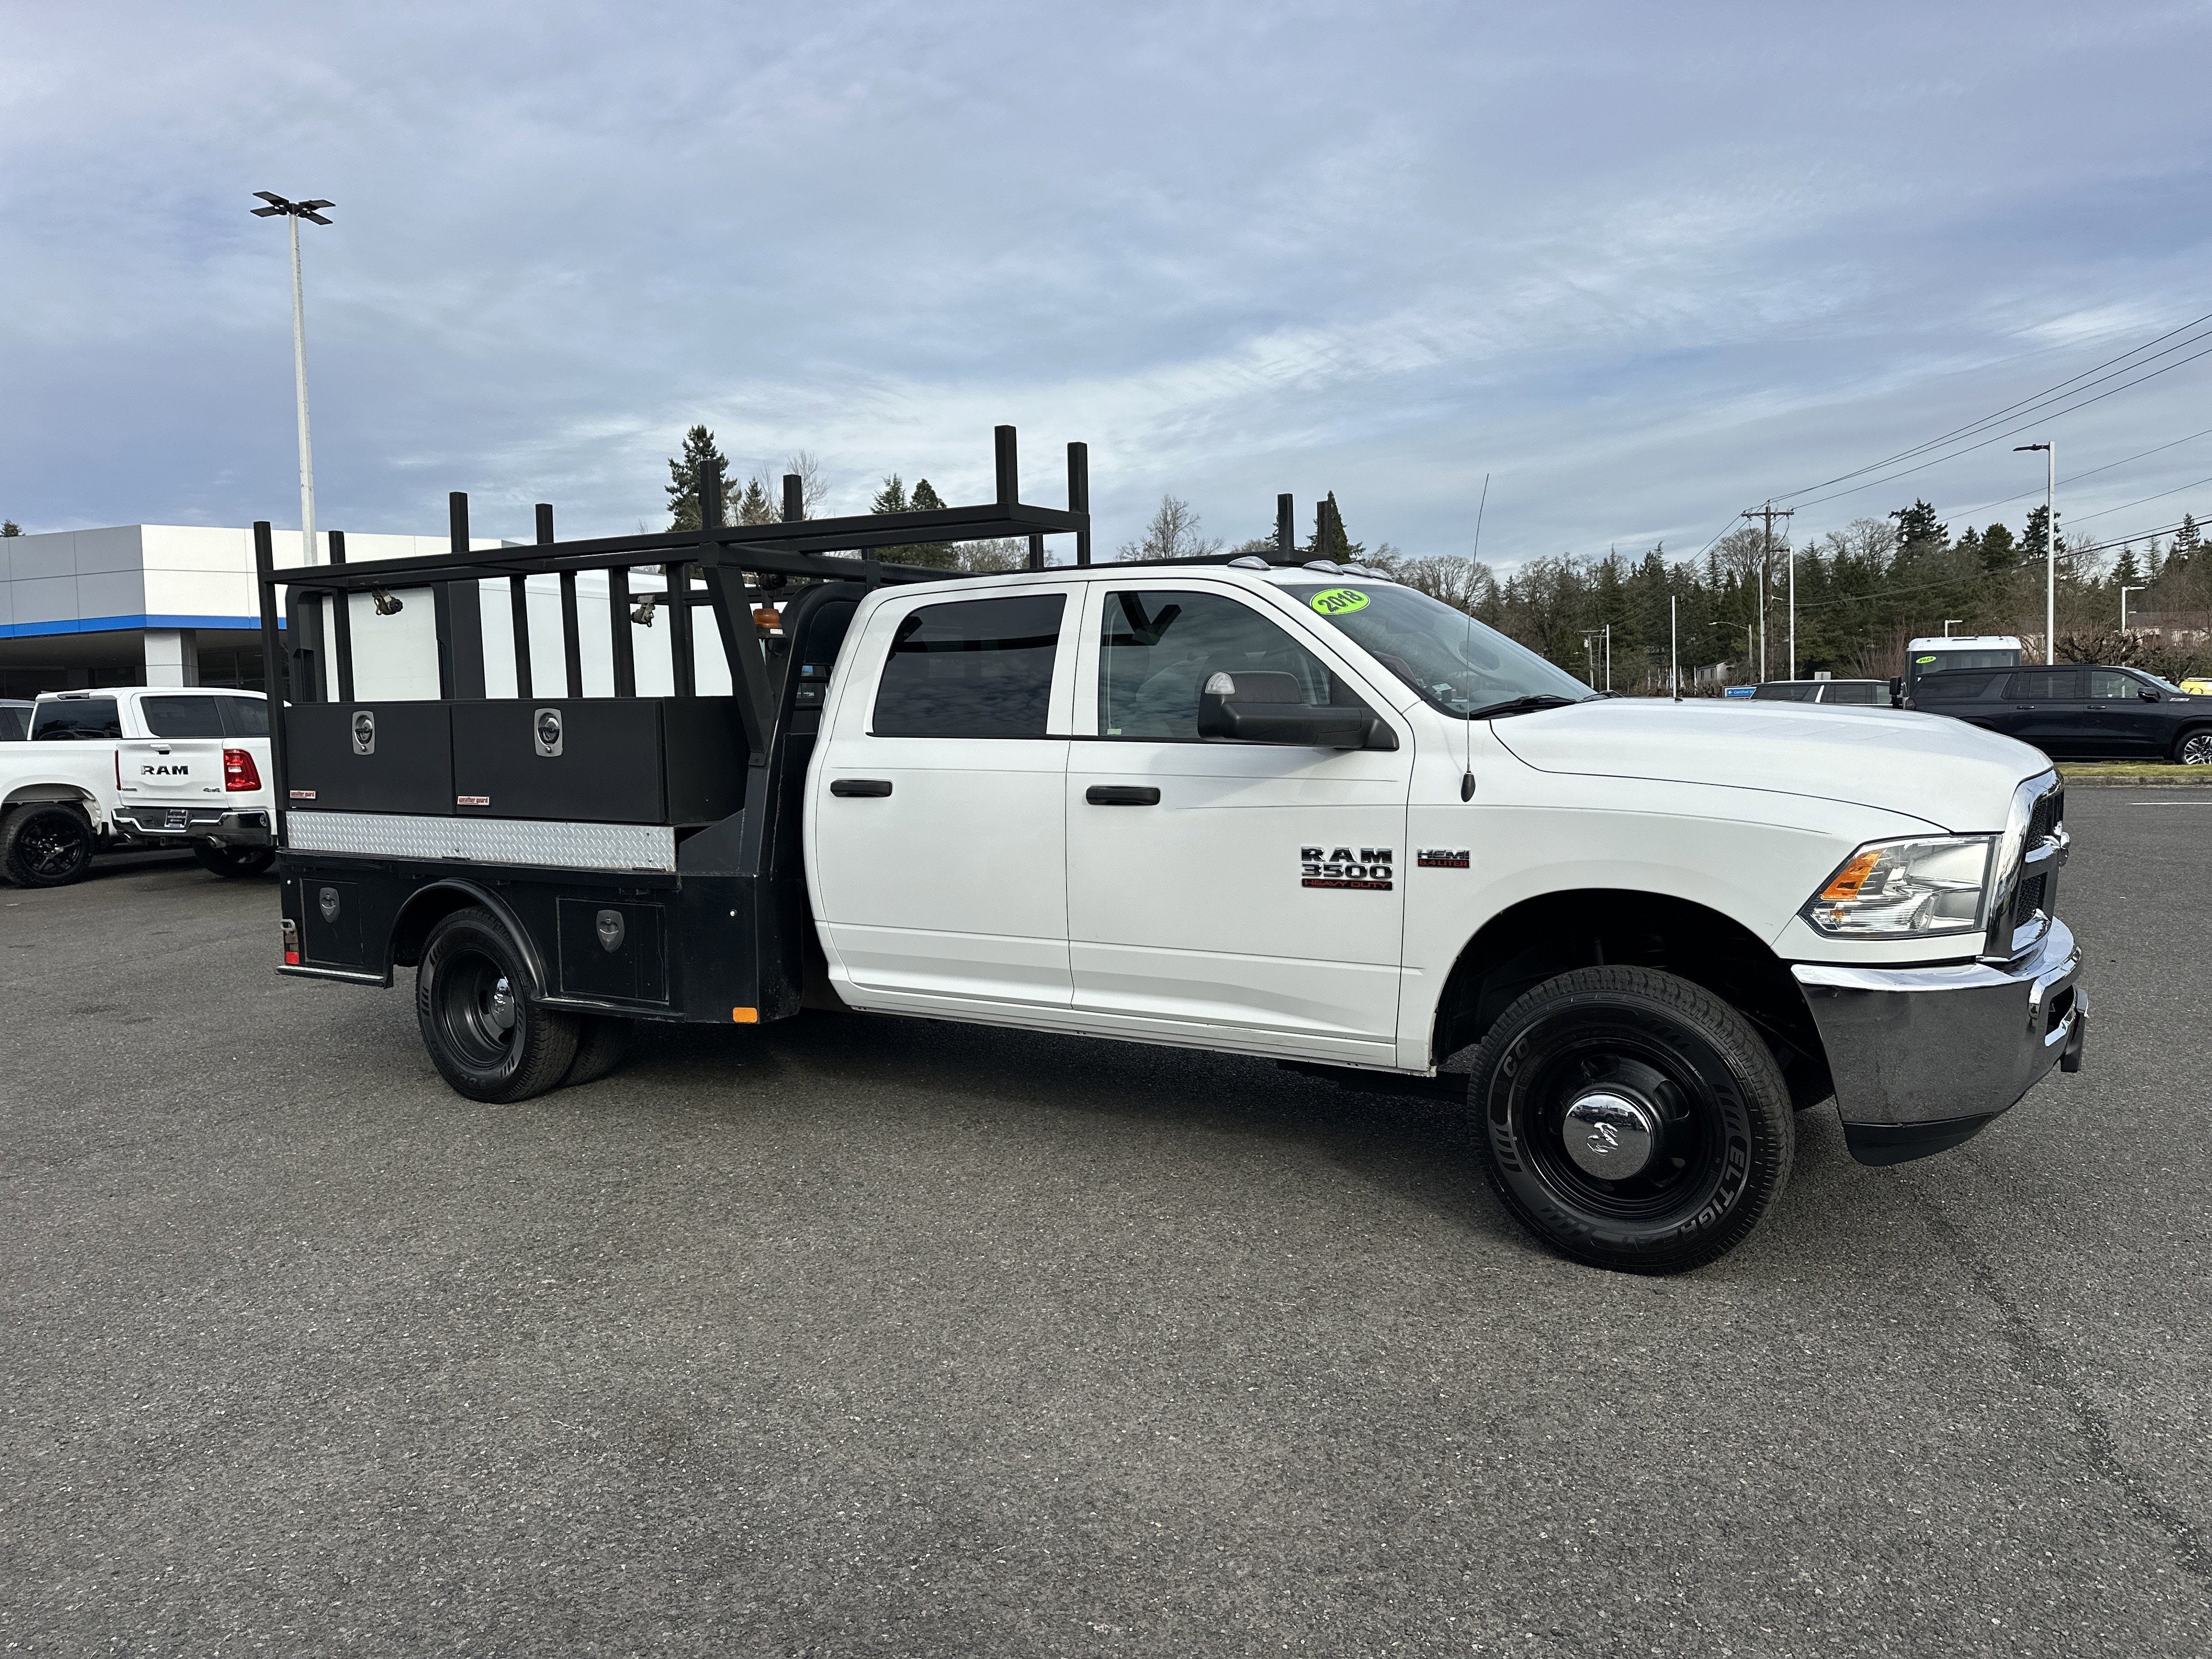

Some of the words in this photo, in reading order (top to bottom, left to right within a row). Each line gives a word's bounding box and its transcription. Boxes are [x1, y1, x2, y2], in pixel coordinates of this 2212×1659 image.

[1317, 590, 1364, 613] 2018
[140, 765, 189, 775] RAM
[1301, 846, 1393, 864] RAM
[1418, 849, 1471, 860] HEMI
[1301, 863, 1393, 880] 3500
[1351, 881, 1389, 889] DUTY
